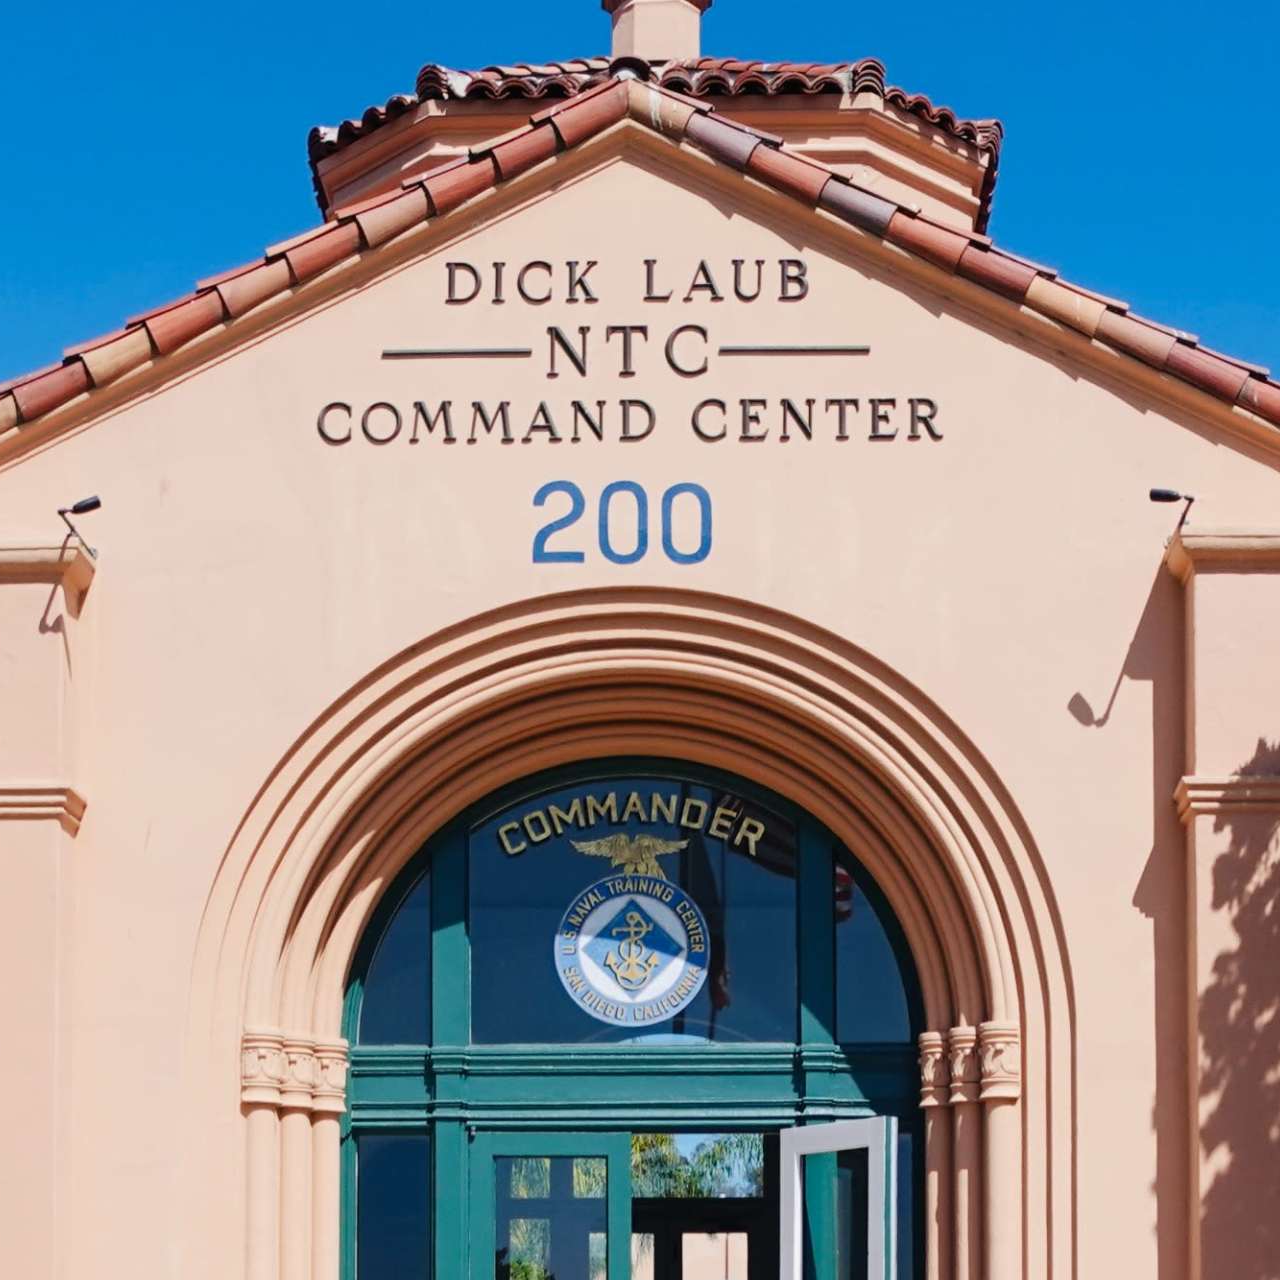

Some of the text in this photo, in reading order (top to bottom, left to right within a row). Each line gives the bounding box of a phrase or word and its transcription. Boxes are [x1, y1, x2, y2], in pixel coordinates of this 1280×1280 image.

[444, 259, 810, 304] DICK LAUB
[546, 325, 709, 378] NTC
[316, 397, 944, 445] COMMAND CENTER
[531, 480, 712, 565] 200
[497, 790, 766, 857] COMMANDER
[568, 889, 606, 926] NAVAL
[606, 878, 675, 903] TRAINING
[675, 900, 705, 953] CENTER
